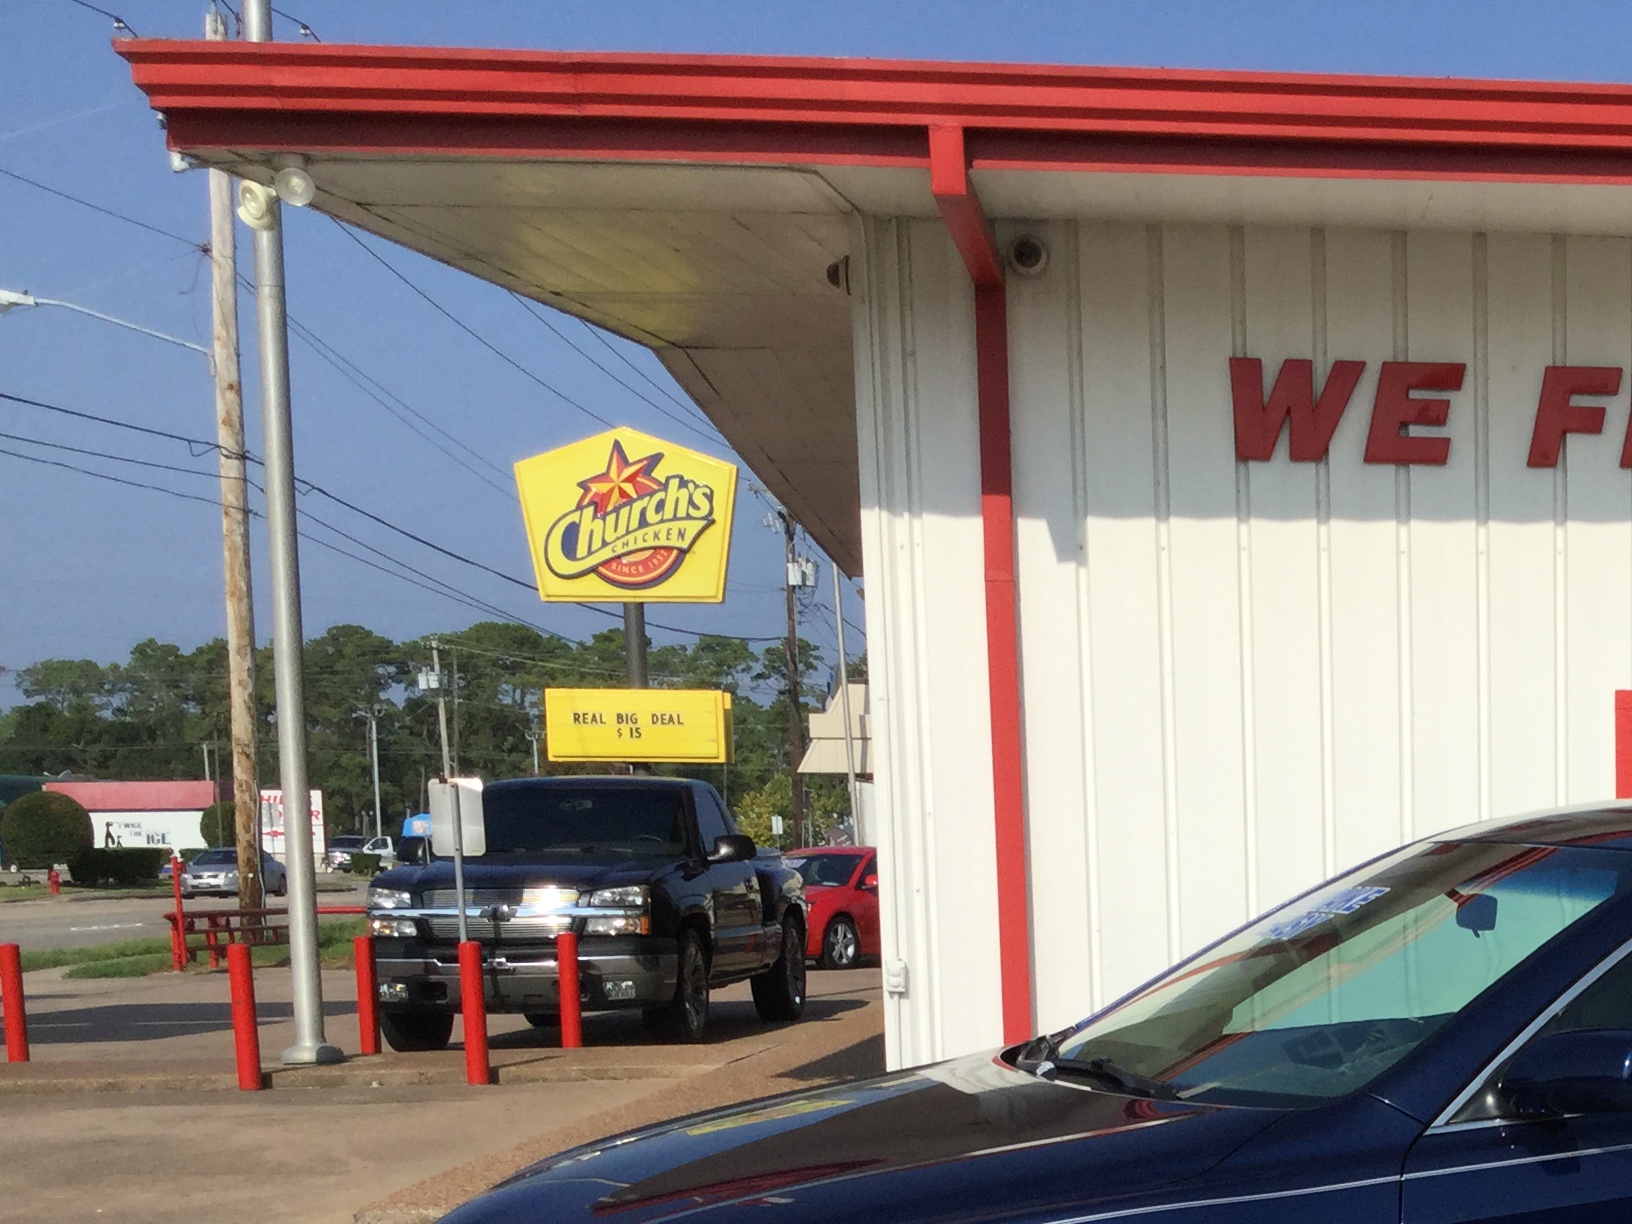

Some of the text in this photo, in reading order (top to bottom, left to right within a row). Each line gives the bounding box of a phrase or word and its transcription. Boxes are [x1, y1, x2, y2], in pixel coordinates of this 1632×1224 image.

[1229, 356, 1467, 465] WE
[545, 474, 715, 576] Church's
[611, 527, 687, 554] CHICKEN
[611, 561, 645, 575] SINCE
[573, 712, 685, 726] REAL BIG DEAL
[616, 726, 642, 739] $ 15
